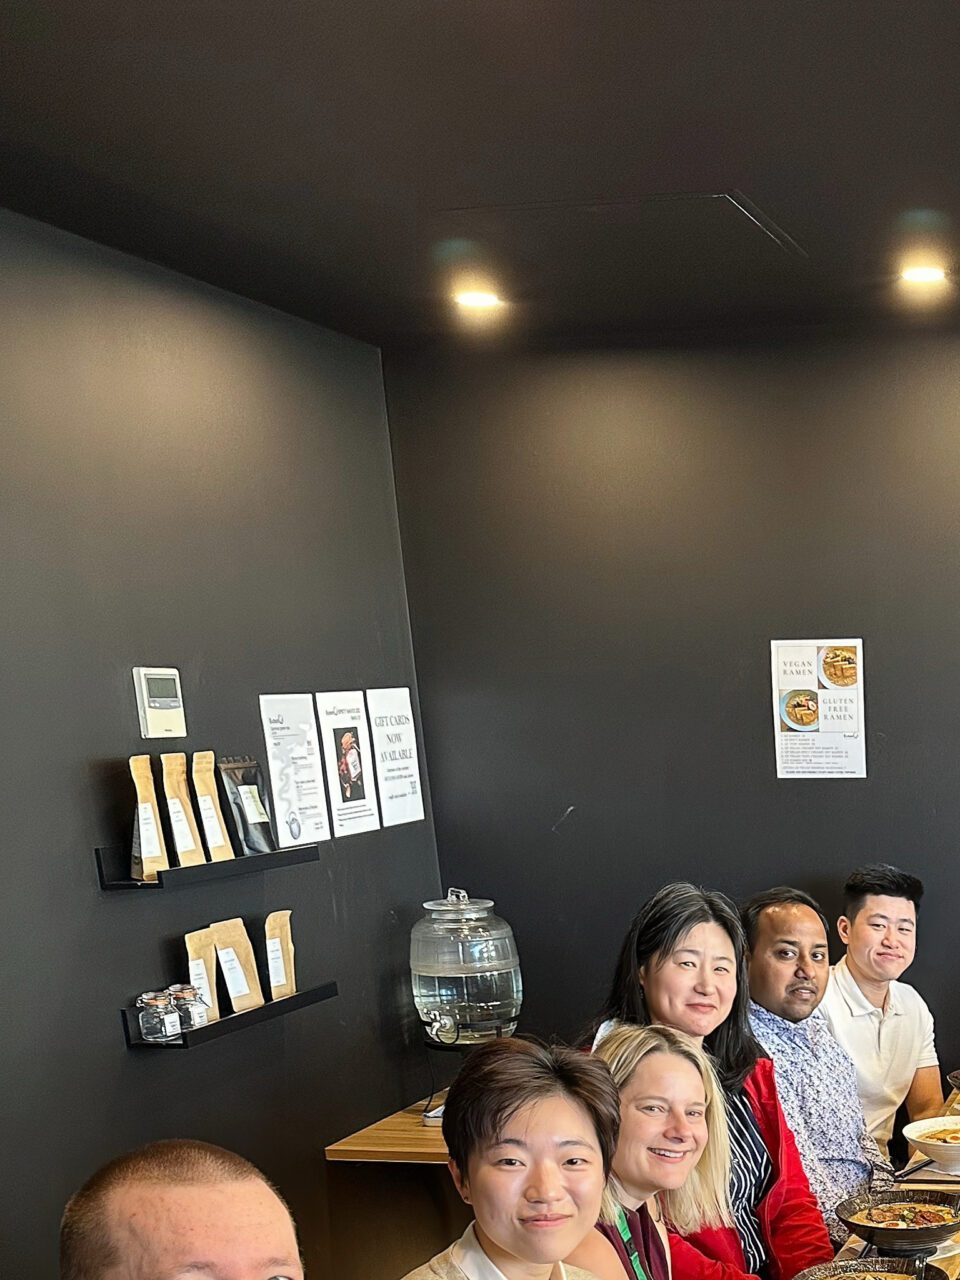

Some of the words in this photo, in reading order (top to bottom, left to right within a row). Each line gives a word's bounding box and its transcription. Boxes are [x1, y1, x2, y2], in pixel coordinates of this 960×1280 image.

[783, 660, 813, 668] VEGAN
[375, 716, 389, 727] GIFT
[389, 714, 411, 726] CARDS
[386, 733, 403, 744] NOW
[380, 748, 414, 763] AVAILABLE
